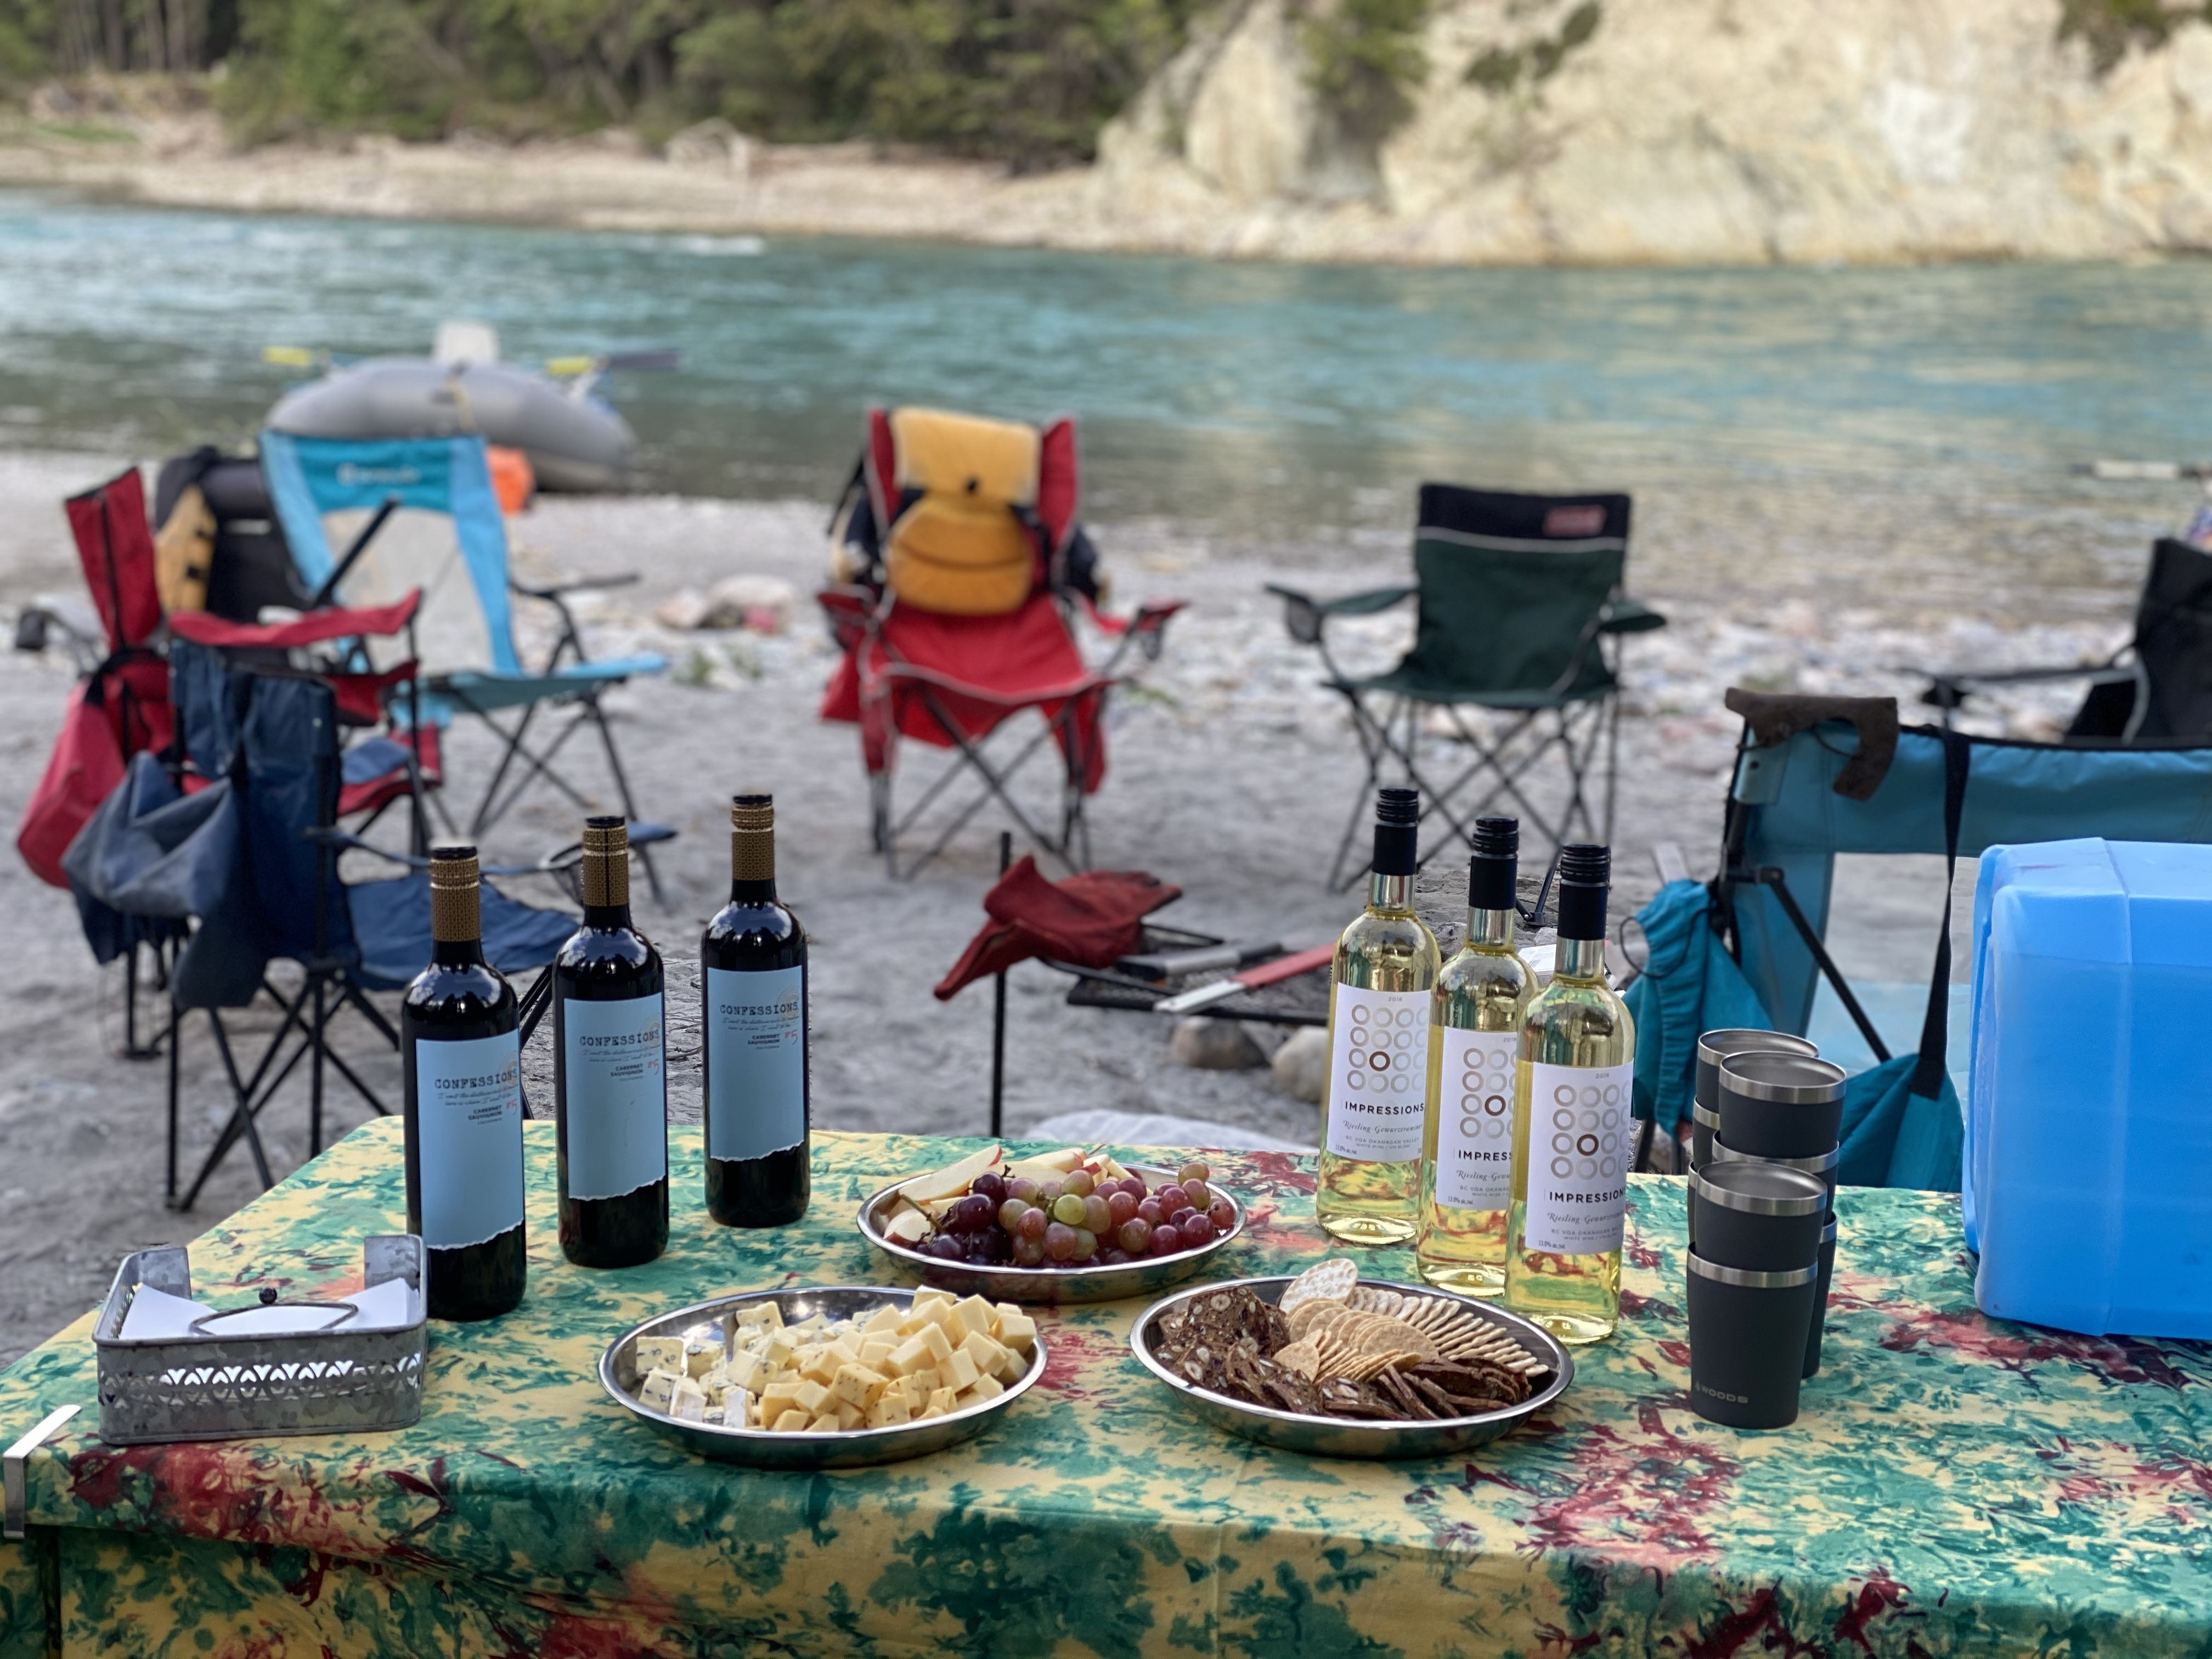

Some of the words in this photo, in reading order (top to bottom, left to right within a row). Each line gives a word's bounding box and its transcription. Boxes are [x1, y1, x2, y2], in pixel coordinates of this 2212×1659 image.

[719, 1001, 798, 1015] CONFESSIONS
[579, 1029, 659, 1046] CONFESSIONS
[1345, 1101, 1424, 1115] IMPRESSIONS
[1343, 1120, 1372, 1133] Riesling
[1456, 1170, 1487, 1182] Riesling
[1547, 1212, 1580, 1225] Riesling
[1702, 1385, 1749, 1404] WOODS
